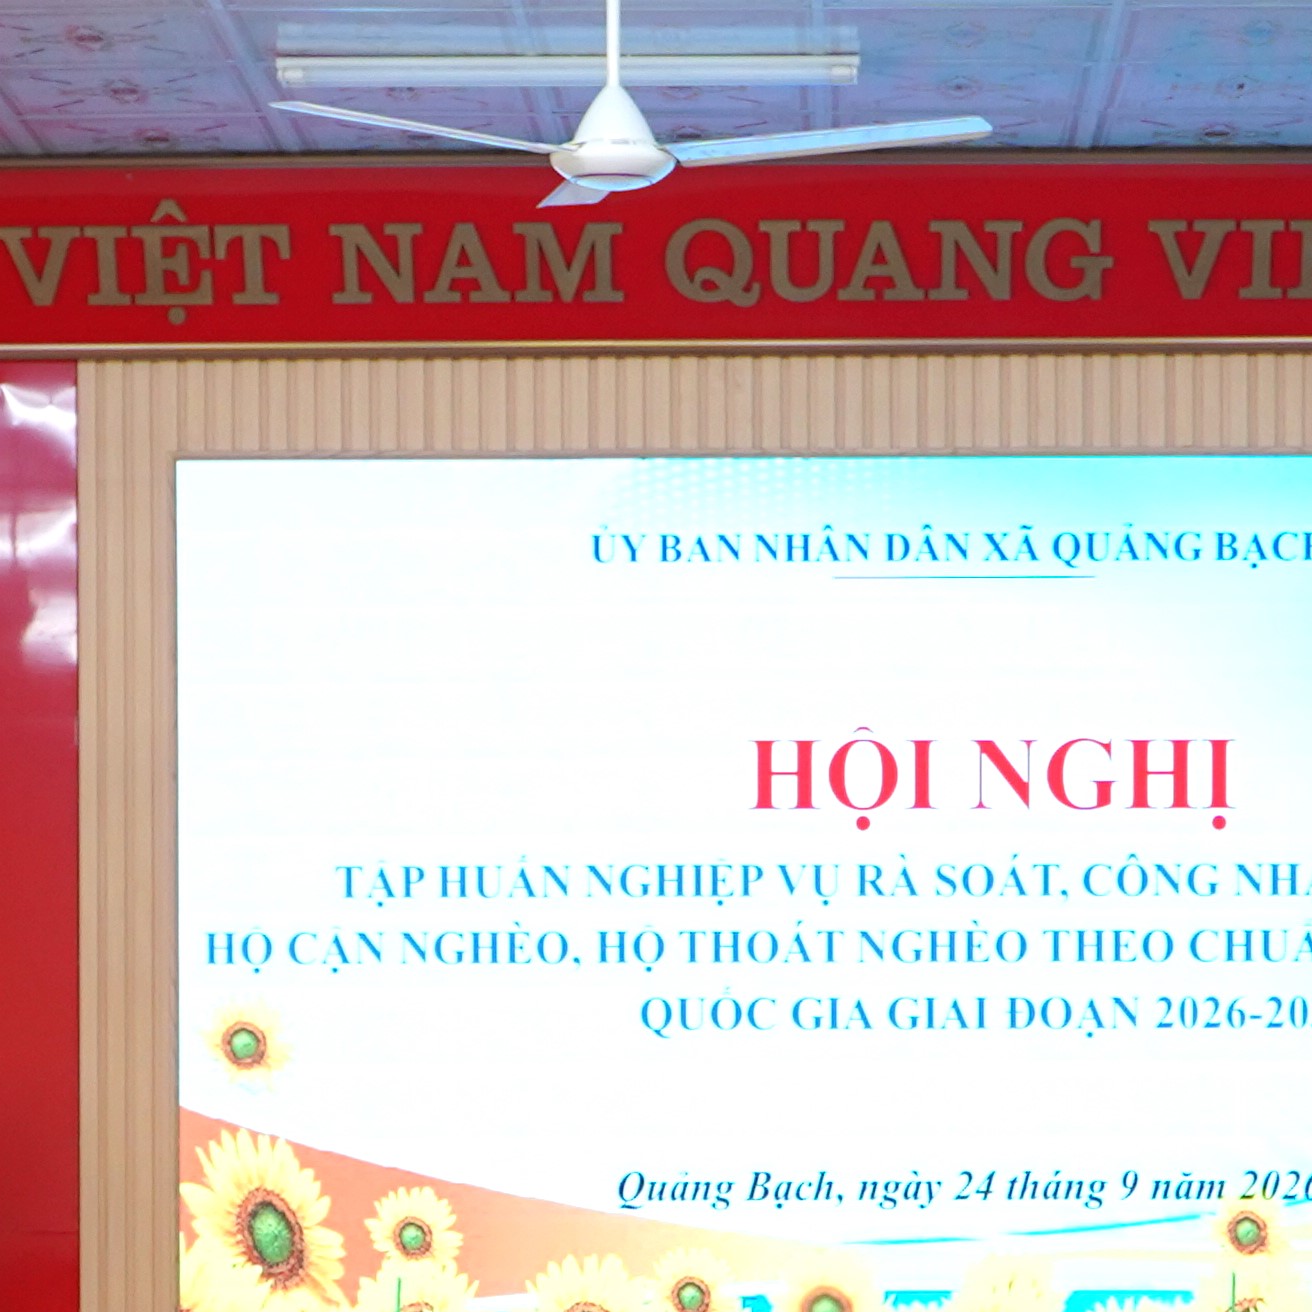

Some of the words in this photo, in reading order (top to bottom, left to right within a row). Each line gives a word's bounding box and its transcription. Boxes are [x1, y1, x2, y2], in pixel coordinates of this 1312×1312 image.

[329, 222, 624, 303] NAM
[666, 218, 1113, 307] QUANG
[591, 525, 647, 564] ỦY
[659, 535, 742, 563] BAN
[754, 525, 869, 562] NHÂN
[885, 524, 969, 562] DÂN
[982, 525, 1040, 562] XÃ
[1051, 523, 1202, 569] QUẢNG
[752, 727, 935, 831] HỘI
[973, 738, 1233, 831] NGHỊ
[334, 859, 426, 908] TẬP
[438, 854, 569, 899] HUẤN
[585, 859, 765, 907] NGHIỆP
[776, 865, 840, 907] VỤ
[857, 855, 919, 897] RÀ
[935, 854, 1070, 903] SOÁT,
[1082, 854, 1219, 897] CÔNG
[206, 926, 274, 974] HỘ
[287, 926, 383, 974] CẬN
[401, 922, 582, 969] NGHÈO,
[598, 925, 666, 973] HỘ
[678, 921, 846, 963] THOÁT
[858, 920, 1029, 963] NGHÈO
[1041, 931, 1175, 962] THEO
[639, 987, 777, 1039] QUỐC
[790, 998, 874, 1030] GIA
[887, 998, 987, 1030] GIAI
[1007, 998, 1138, 1039] ĐOẠN
[616, 1172, 736, 1211] Quảng
[745, 1171, 845, 1210] Bạch,
[857, 1171, 943, 1210] ngày
[953, 1171, 997, 1201] 24
[1005, 1171, 1109, 1209] tháng
[1120, 1171, 1140, 1199] 9
[1150, 1172, 1227, 1201] năm
